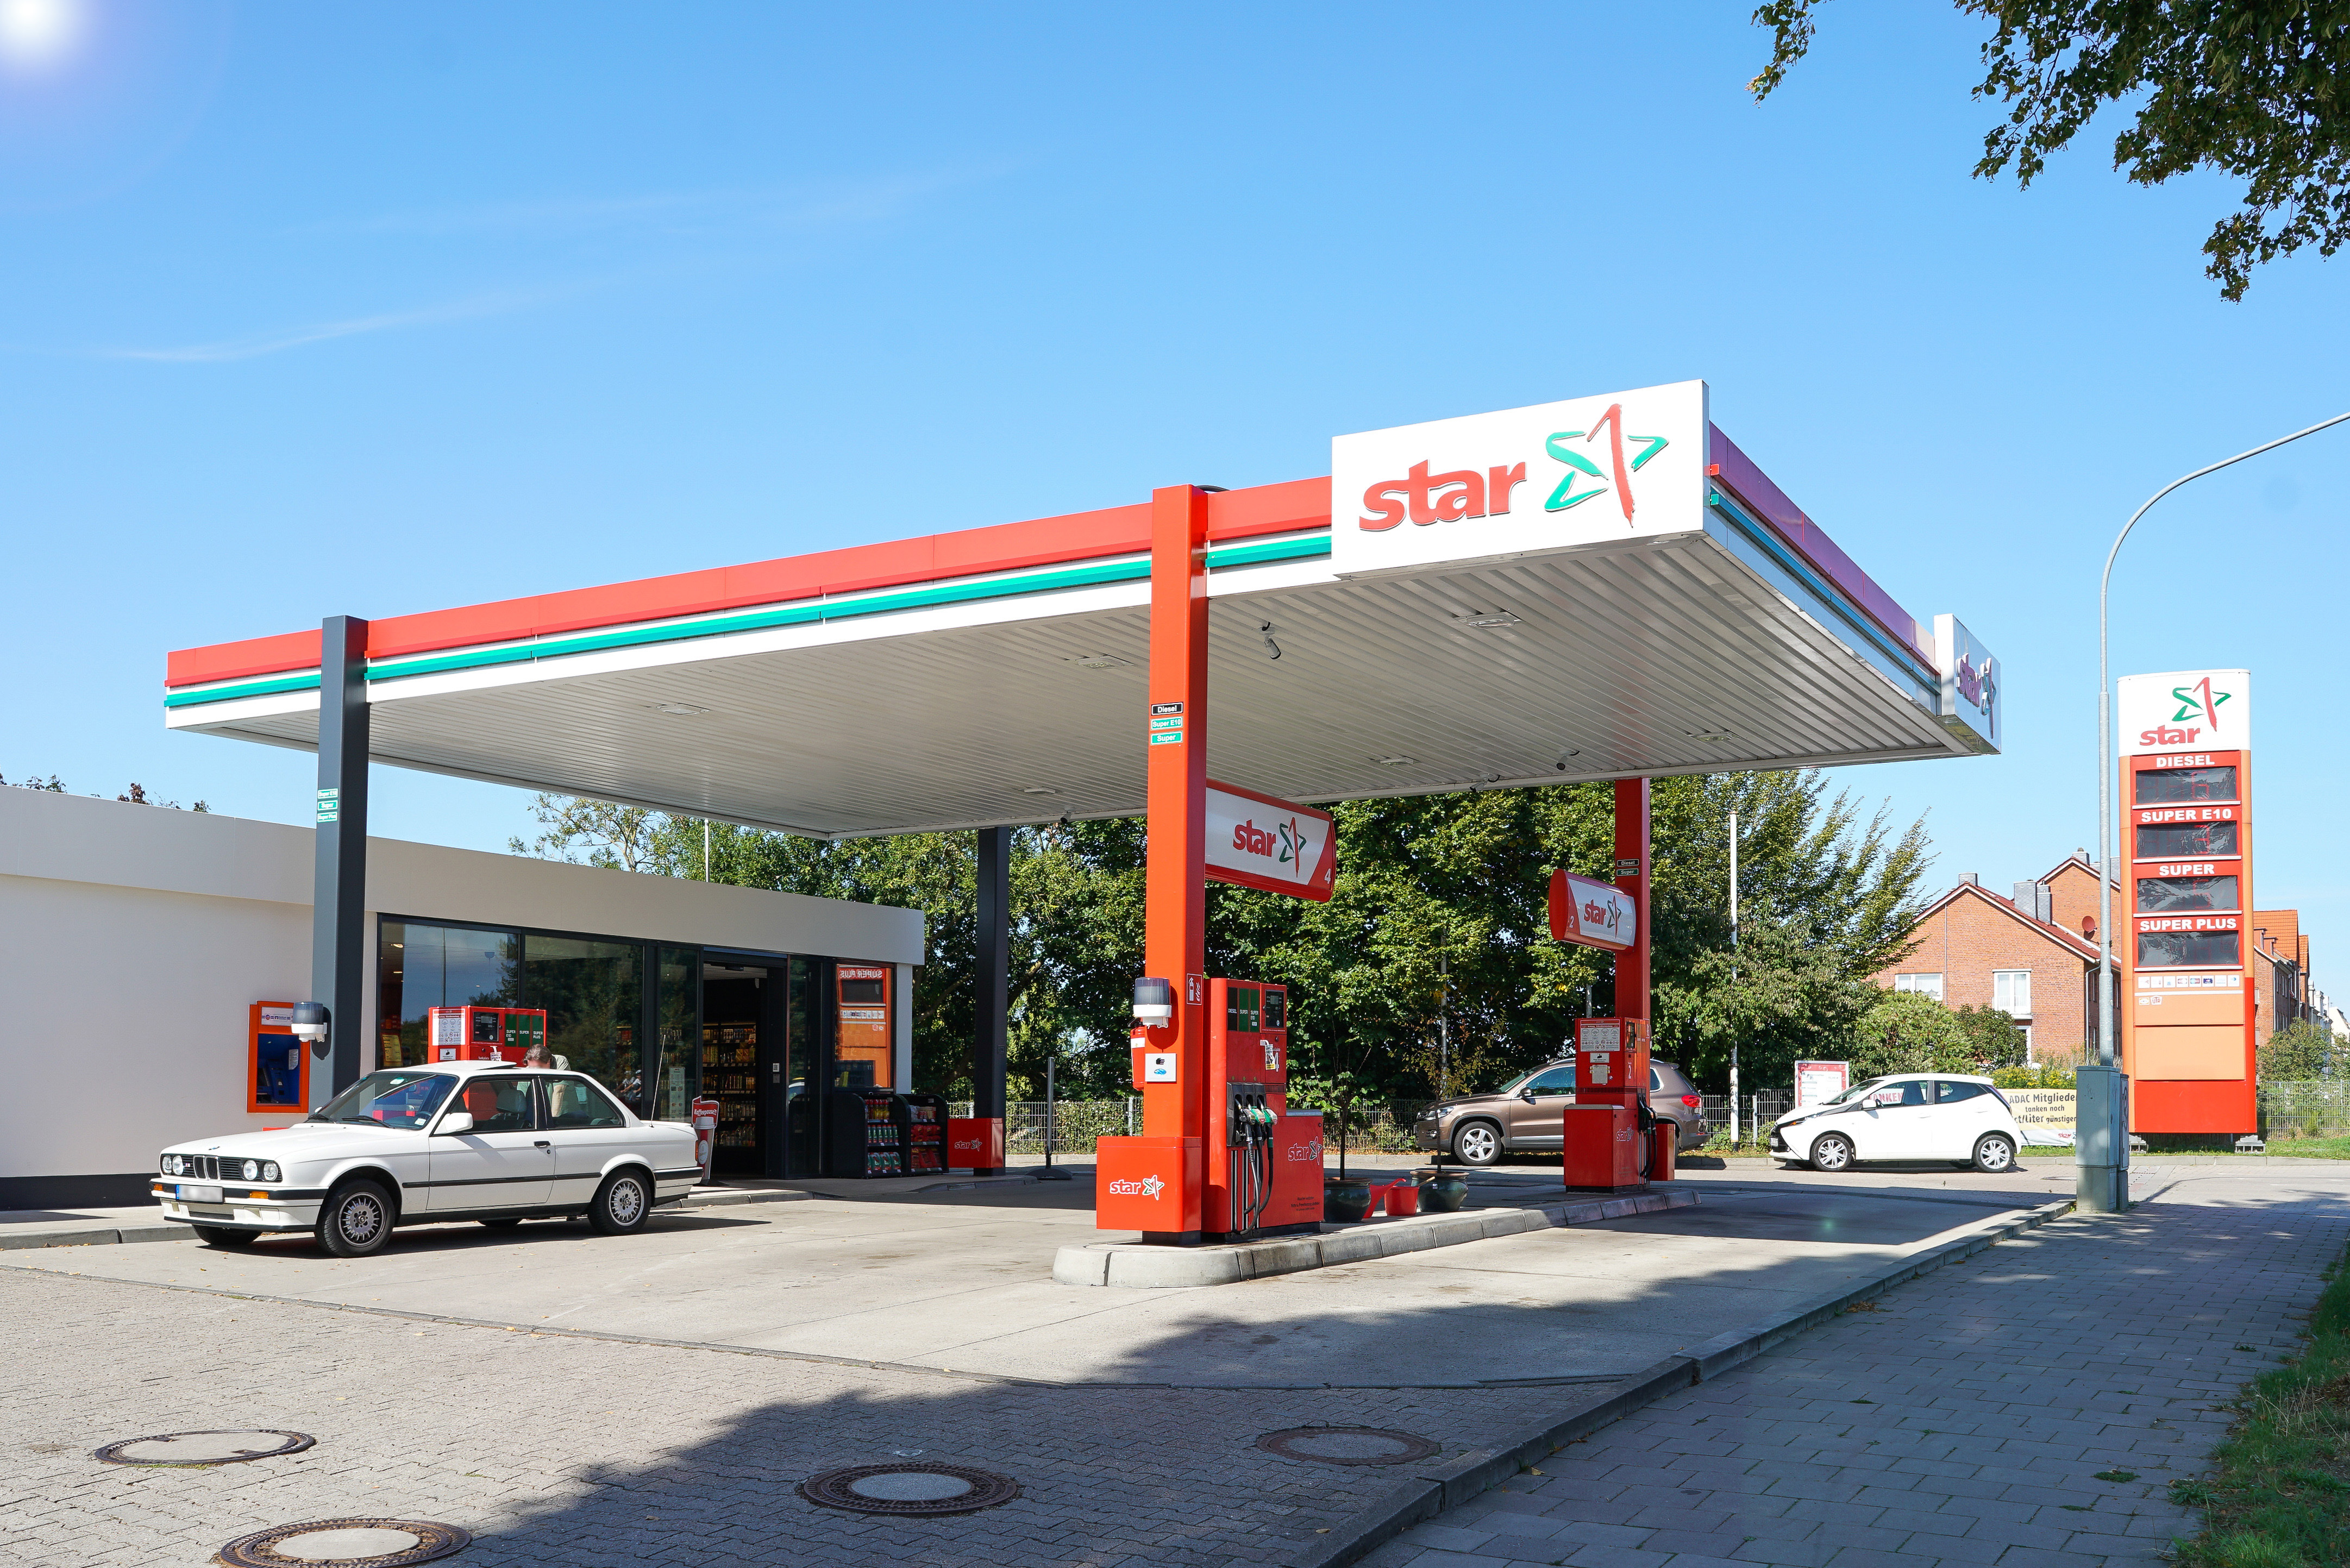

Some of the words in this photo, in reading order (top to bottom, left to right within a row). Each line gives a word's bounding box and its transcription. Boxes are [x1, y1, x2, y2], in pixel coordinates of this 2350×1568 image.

[1359, 459, 1527, 532] star
[2139, 725, 2201, 746] star
[2156, 755, 2215, 768] DIESEL
[2141, 810, 2197, 823] SUPER
[2202, 808, 2232, 820] E10
[1233, 819, 1277, 858] star
[1324, 868, 1331, 884] 4
[2159, 864, 2215, 876] SUPER
[1584, 899, 1606, 926] star
[1569, 915, 1575, 929] 2
[2140, 919, 2193, 931] SUPER
[2196, 918, 2237, 929] PLUS
[1628, 1065, 1632, 1080] 2
[2009, 1094, 2030, 1104] ADAC
[2033, 1092, 2077, 1104] Mitgliede
[955, 1140, 970, 1149] star
[1288, 1143, 1309, 1161] star
[1110, 1179, 1141, 1194] star
